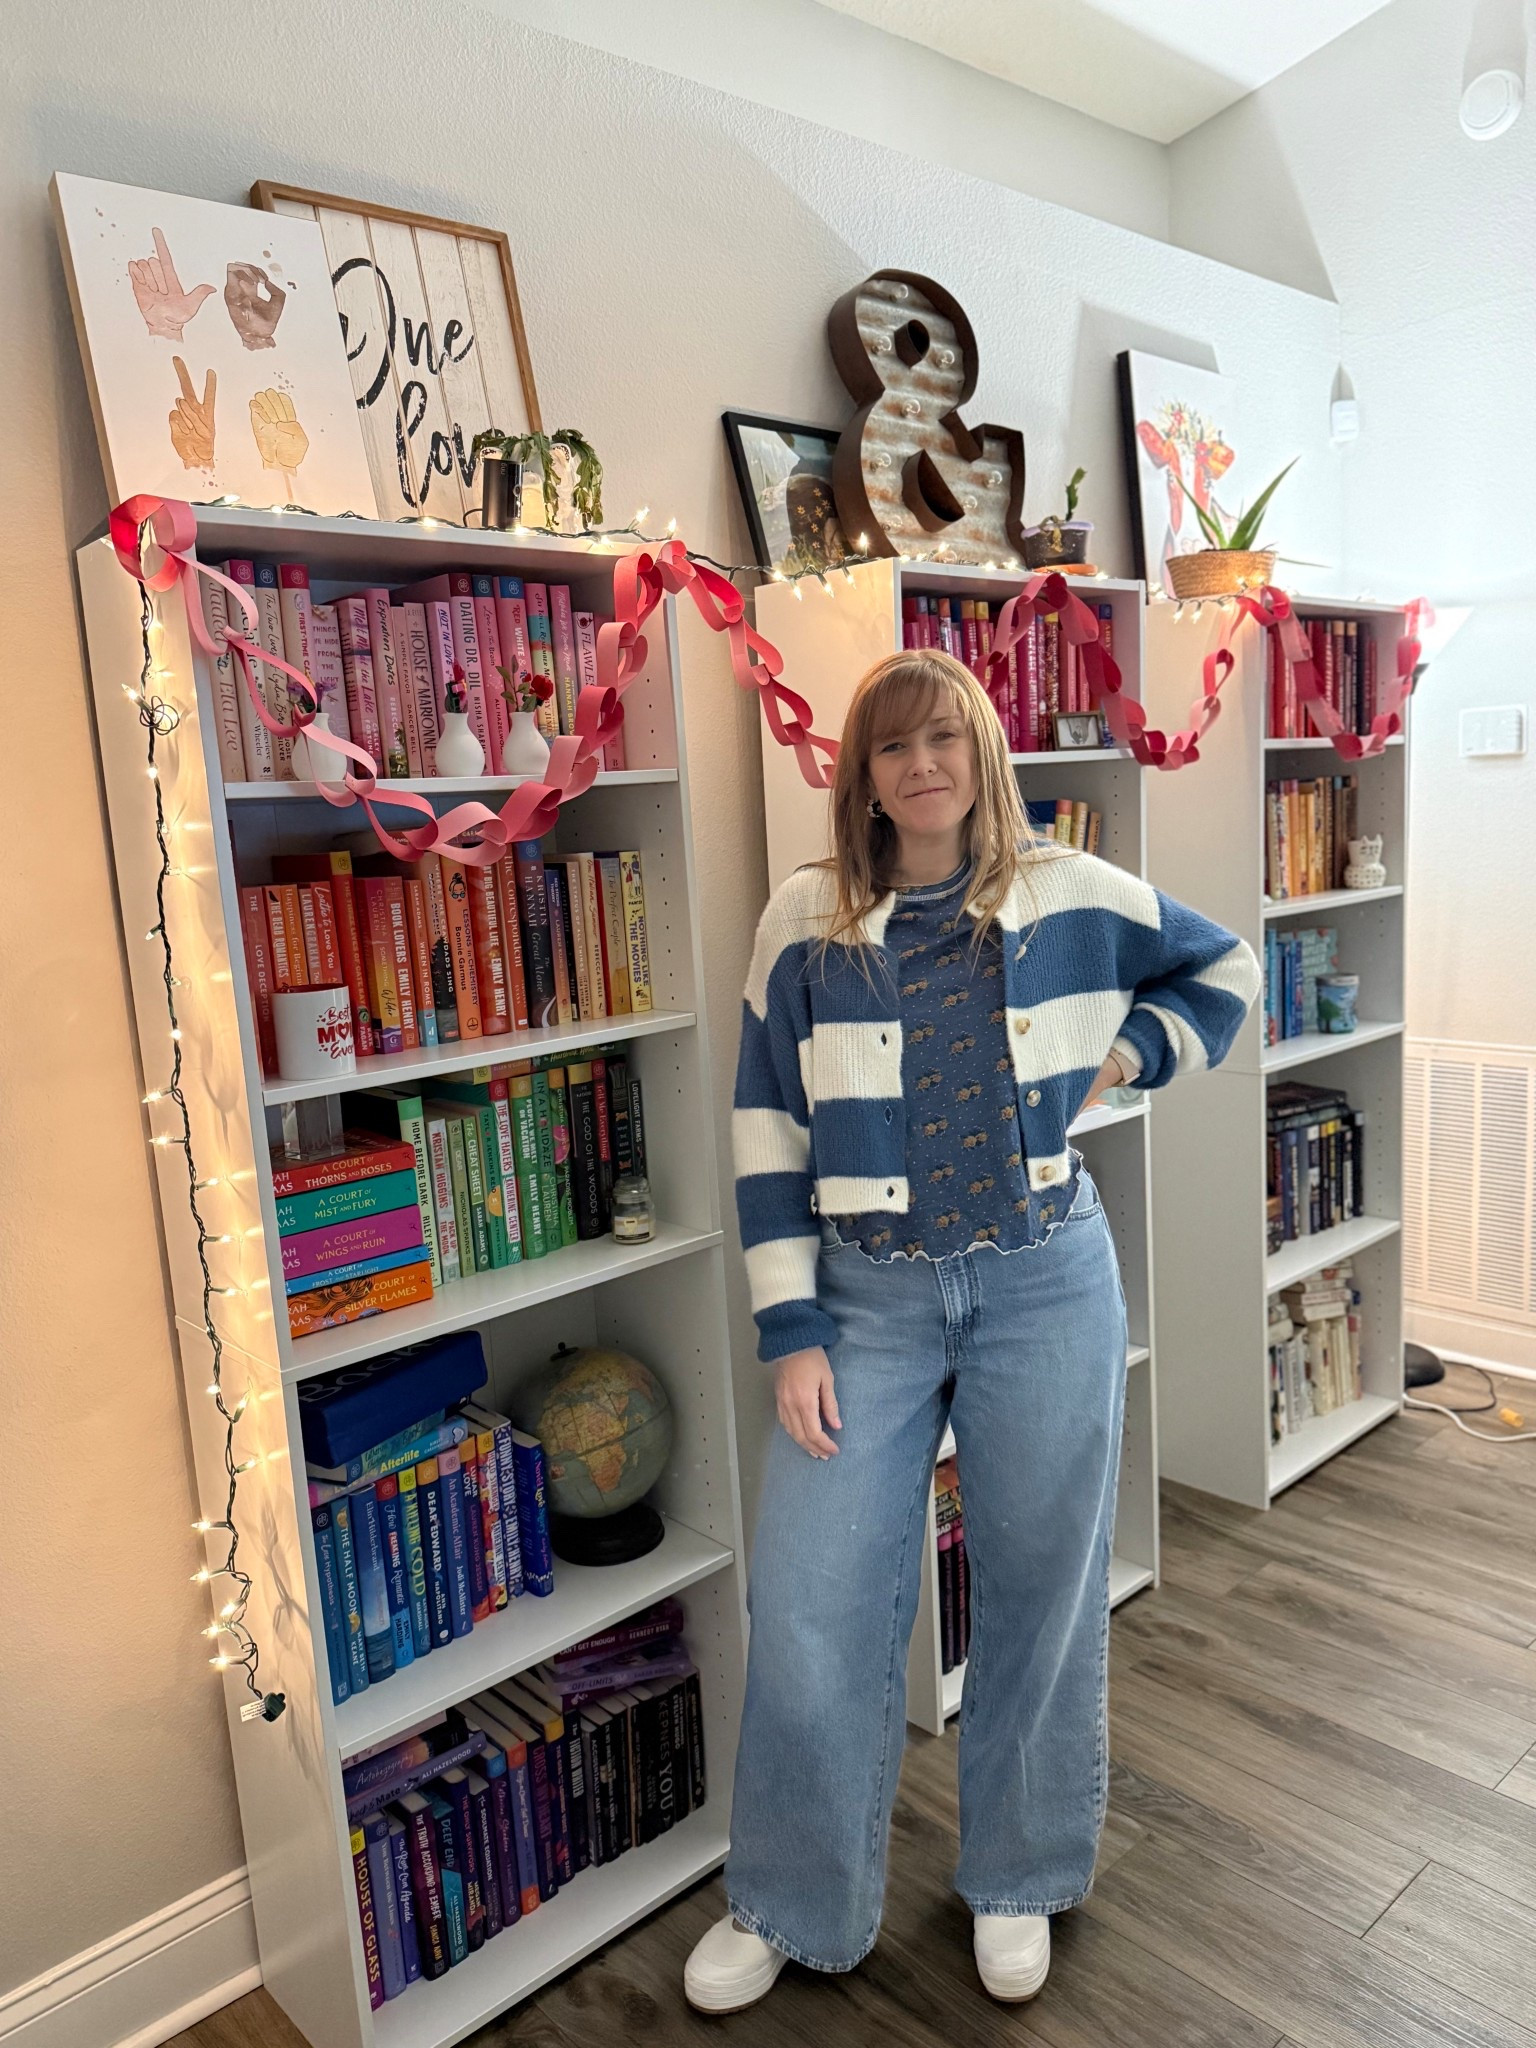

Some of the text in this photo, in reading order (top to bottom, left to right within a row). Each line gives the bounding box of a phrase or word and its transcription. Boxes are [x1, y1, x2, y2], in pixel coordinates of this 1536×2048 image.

[265, 593, 275, 609] The
[376, 599, 396, 686] Expiration Dates
[515, 628, 526, 657] WHITE
[460, 602, 483, 721] DATING DR. DIL NISHA
[411, 630, 437, 752] HOUSE MARIONNE
[564, 677, 573, 711] HANNAH
[224, 719, 238, 751] Lee
[406, 704, 415, 733] DARCEY
[254, 724, 262, 756] Wheeler
[484, 877, 494, 890] BIG
[524, 876, 538, 927] HANNAH
[536, 875, 548, 925] KRISTIN
[371, 896, 380, 931] LAUREN
[485, 892, 498, 930] BEAUTIFUL
[506, 881, 523, 967] Correspondent
[302, 894, 320, 968] LAUREN GRAHAM
[324, 929, 332, 950] Love
[489, 932, 499, 947] LIFE
[250, 895, 271, 1022] THE LOVE DECEPTION
[391, 903, 415, 1030] BOOK LOVERS EMILY HENRY
[440, 919, 454, 992] CRAWDADS SING
[455, 926, 467, 990] Bonnie Garmus
[463, 908, 479, 1006] LESSONS CHEMISTRY
[631, 943, 642, 984] MOVIES
[638, 916, 650, 988] NOTHING LIKE
[420, 943, 432, 1005] WHEN ROME
[491, 958, 504, 984] EMILY
[324, 1004, 350, 1026] Best
[494, 988, 507, 1016] HENRY
[631, 1083, 643, 1142] LOVELIGHT FARMS
[468, 1139, 479, 1169] CHEAT
[520, 1120, 531, 1160] VACATION
[582, 1101, 600, 1215] THE GOD THE WOODS
[305, 1173, 347, 1189] THORNS
[360, 1162, 392, 1177] ROSES
[321, 1157, 365, 1174] A COURT
[412, 1121, 433, 1239] HOME BEFORE DARK RILEY
[431, 1132, 450, 1209] KRISTAN HIGGINS
[470, 1170, 482, 1197] SHEET
[497, 1104, 519, 1241] THE LOVE HATERS KATHERINE CENTER
[314, 1198, 377, 1219] MIST FURY
[329, 1189, 363, 1205] COURT
[529, 1173, 542, 1236] EMILY HENRY
[541, 1184, 551, 1222] LAUREN
[549, 1176, 559, 1226] CHRISTINA
[323, 1230, 368, 1249] A COURT
[448, 1220, 456, 1239] PACK
[460, 1191, 472, 1255] NICHOLAS SPARKS
[315, 1236, 387, 1262] WINGS RUIN
[441, 1235, 450, 1255] MOON
[312, 1278, 333, 1288] FROST
[334, 1264, 357, 1275] COURT
[363, 1275, 405, 1296] A COURT
[344, 1286, 418, 1314] SILVER FLAMES
[380, 1449, 420, 1474] Afterlife
[463, 1472, 471, 1497] LOVE
[470, 1465, 479, 1498] LUNAR
[498, 1436, 522, 1580] FUNNY STORY EMILY HENRY
[368, 1519, 380, 1571] Hilderbrand
[388, 1531, 401, 1568] FREAKING
[405, 1503, 426, 1596] KILLING COLD
[427, 1491, 442, 1571] DEAR EDWARD
[341, 1527, 359, 1617] THE HALF MOON
[450, 1492, 467, 1616] Academic Affair Jodi McAlister
[434, 1580, 444, 1625] NAPOLITANO
[351, 1641, 359, 1667] KEANE
[590, 1635, 616, 1650] ENOUGH
[421, 1748, 472, 1780] ALI HAZELWOOD
[658, 1761, 674, 1811] YOU
[440, 1818, 452, 1848] DEEP
[416, 1825, 443, 1921] TRUTH ACCORDING EMBER
[484, 1845, 494, 1881] EQUATION
[357, 1855, 381, 1983] HOUSE OF GLASS
[401, 1890, 414, 1923] Agenda
